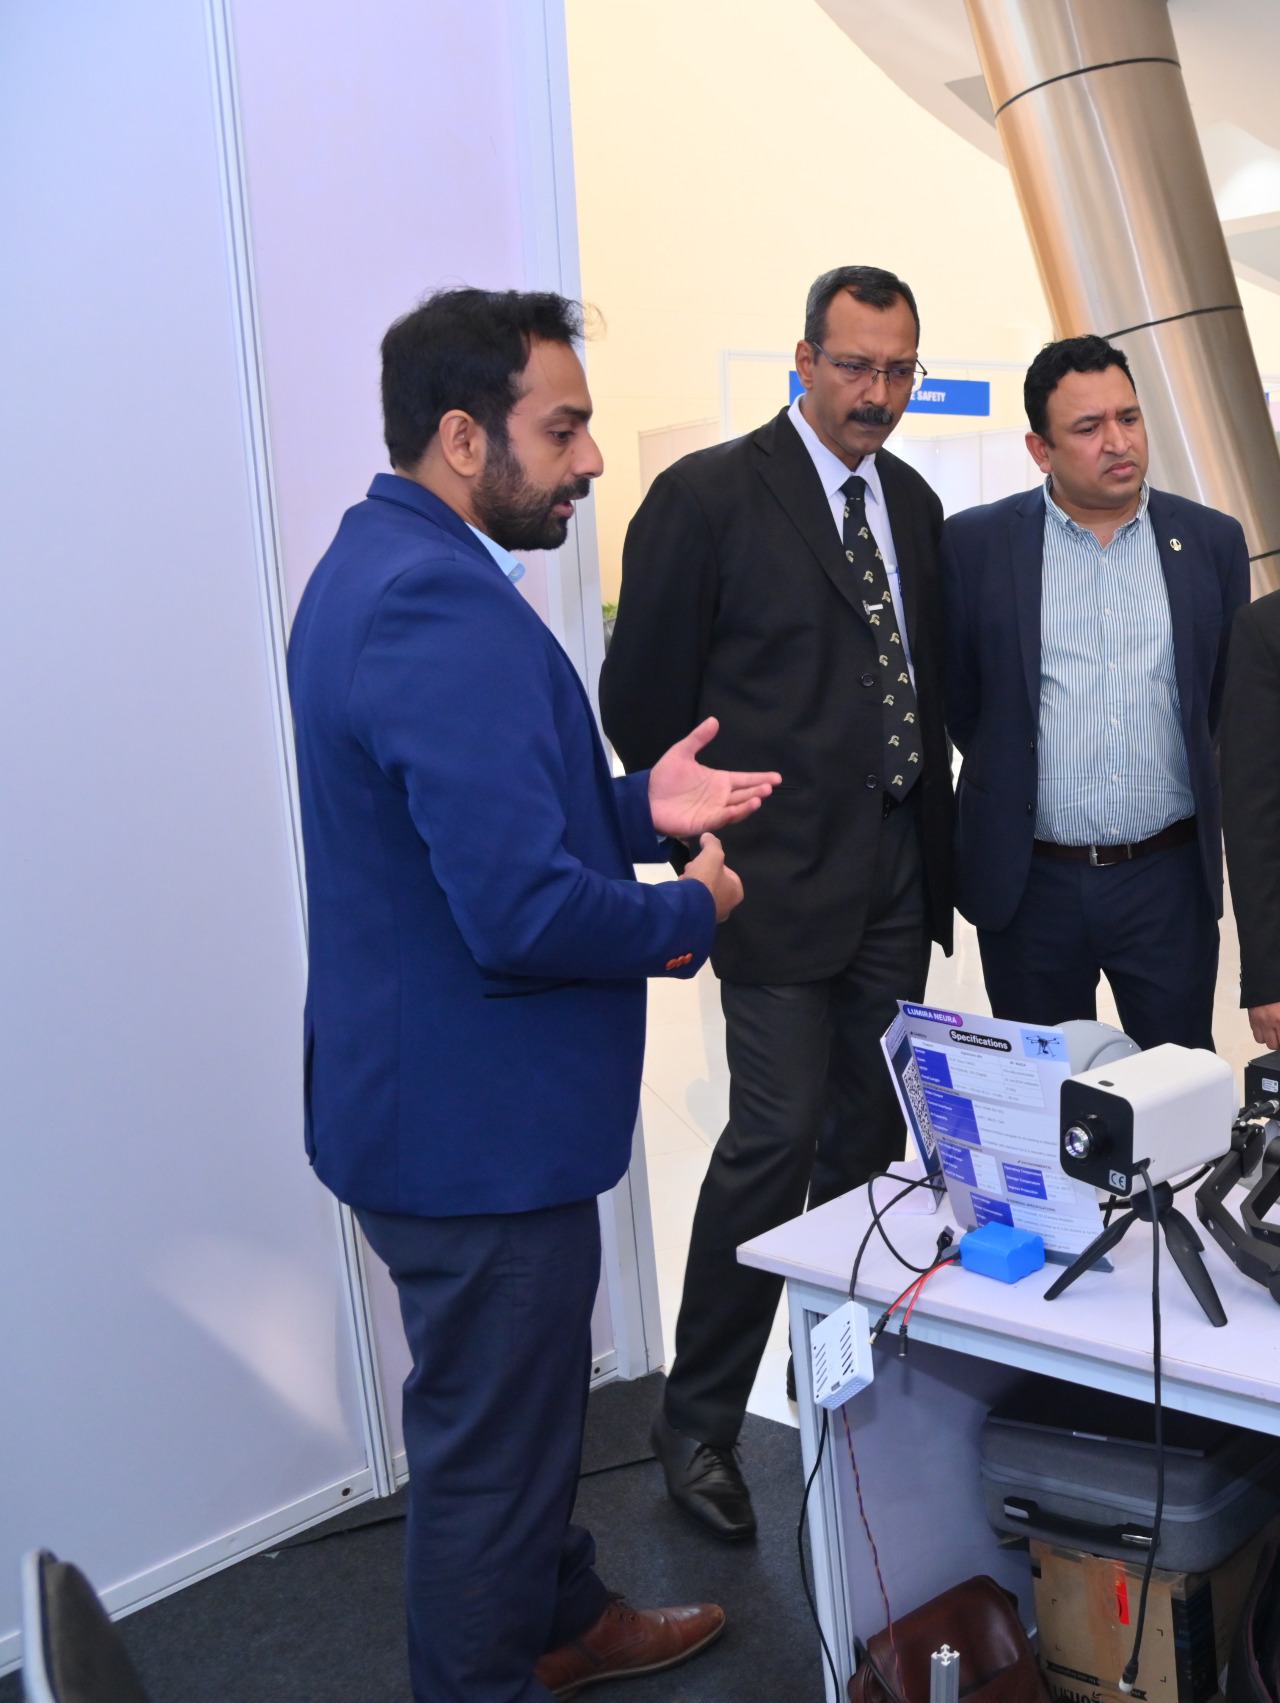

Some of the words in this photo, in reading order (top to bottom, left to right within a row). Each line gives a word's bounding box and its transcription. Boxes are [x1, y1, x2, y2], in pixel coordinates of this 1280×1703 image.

[917, 390, 946, 403] SAFETY
[907, 1007, 933, 1020] LUMIRA
[934, 1012, 958, 1024] NEURA
[950, 1030, 1009, 1050] Specifications
[1111, 1173, 1124, 1188] CE
